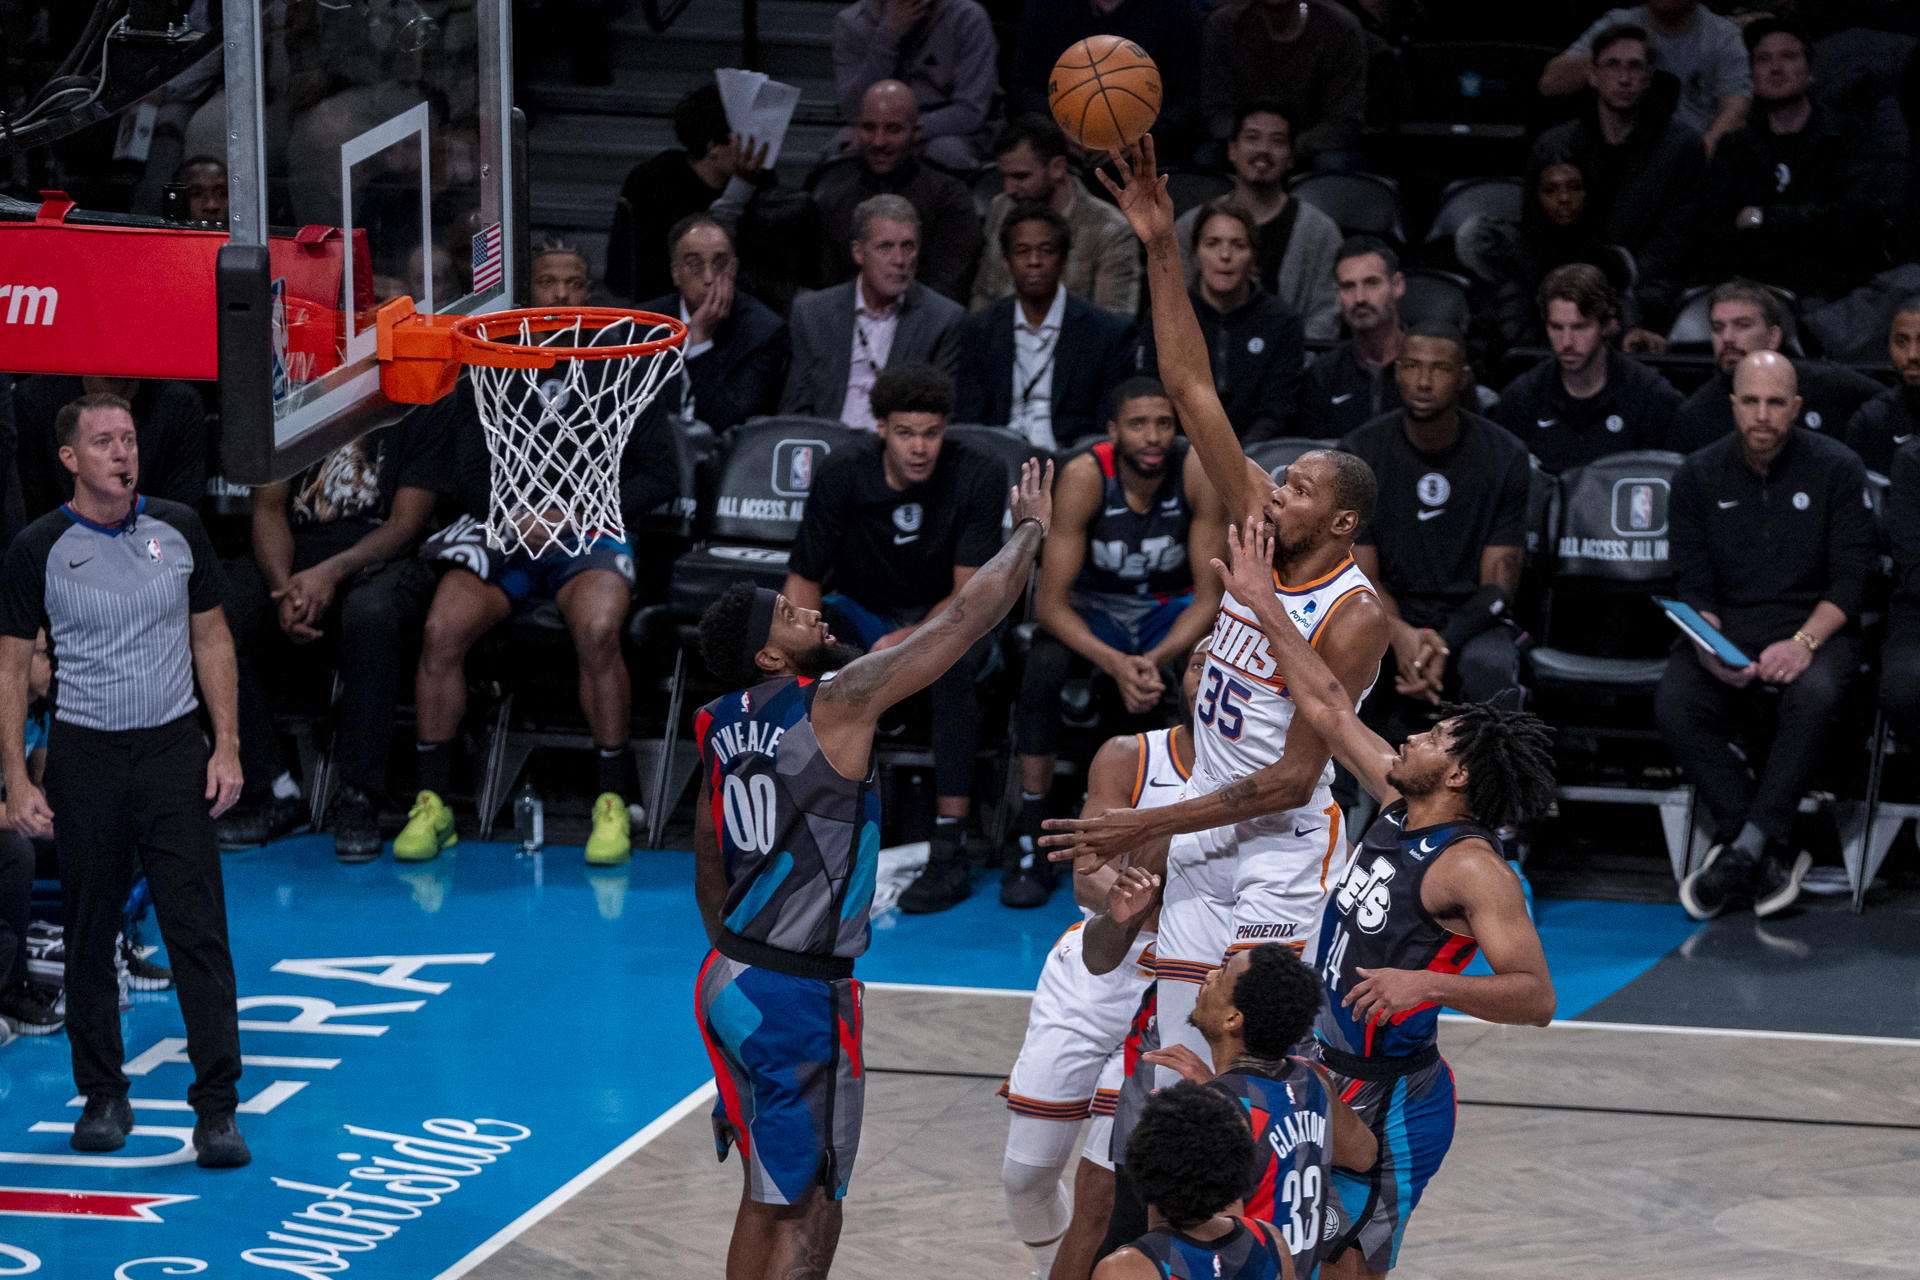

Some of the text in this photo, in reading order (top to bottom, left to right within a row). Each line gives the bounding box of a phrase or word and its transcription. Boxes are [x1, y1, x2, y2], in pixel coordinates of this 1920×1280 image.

[1290, 610, 1312, 628] PayPal
[1198, 665, 1252, 743] 35
[711, 720, 785, 764] O'NEALE
[723, 773, 776, 855] 00
[1236, 923, 1299, 939] PHOENIX
[1268, 1110, 1327, 1160] CLAXTON
[1281, 1165, 1322, 1256] 33
